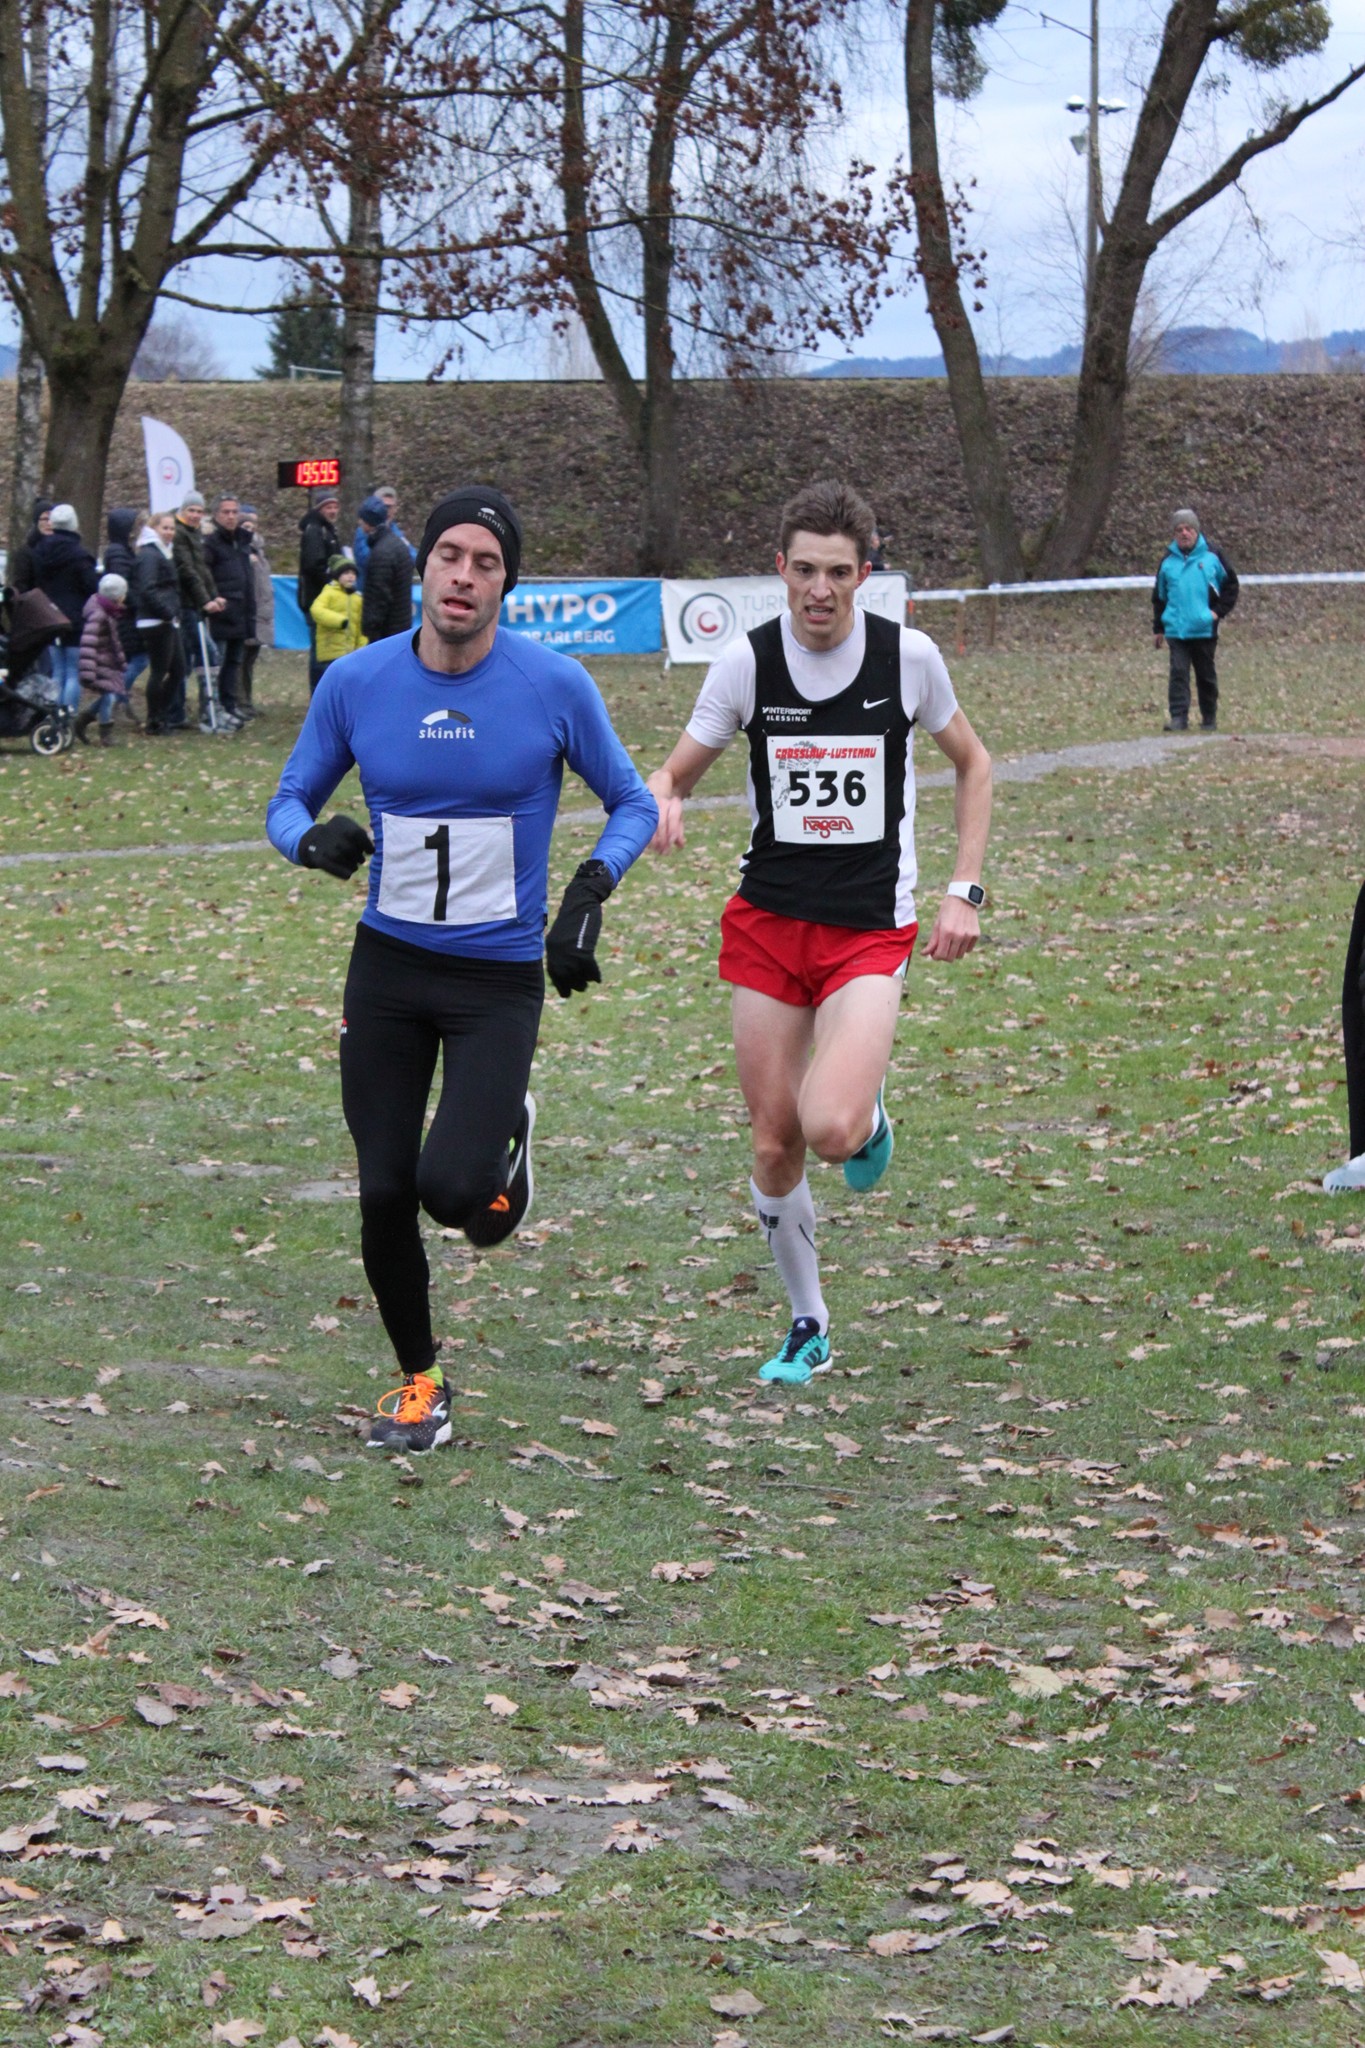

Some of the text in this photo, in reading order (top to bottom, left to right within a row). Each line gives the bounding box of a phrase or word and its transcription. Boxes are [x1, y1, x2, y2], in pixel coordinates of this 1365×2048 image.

[507, 593, 617, 623] HYPO
[520, 630, 615, 644] RARLBERG
[418, 726, 476, 740] skinfit
[789, 770, 867, 807] 536
[424, 824, 451, 922] 1
